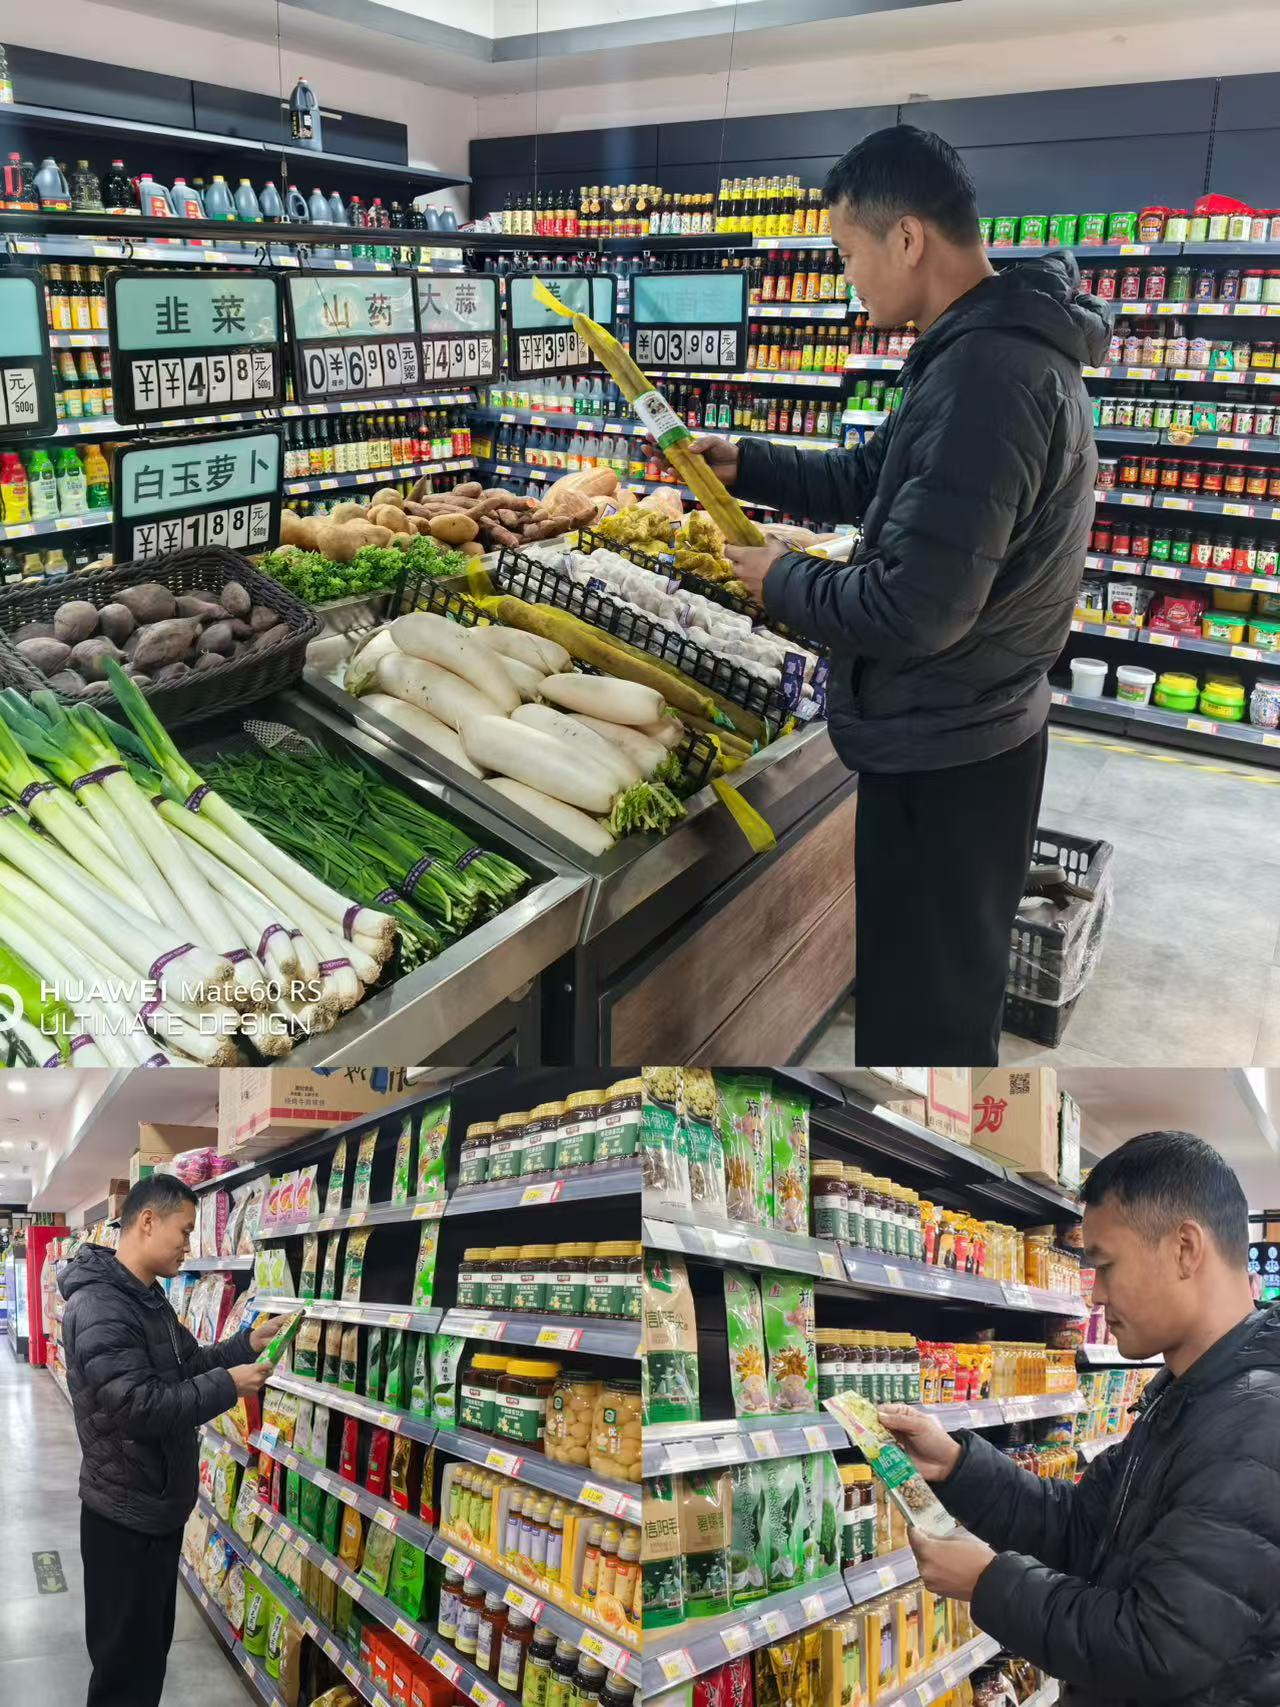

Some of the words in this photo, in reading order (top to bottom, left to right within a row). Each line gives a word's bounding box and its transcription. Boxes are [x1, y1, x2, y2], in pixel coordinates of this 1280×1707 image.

[156, 295, 246, 335] 韭菜
[323, 292, 393, 329] 山药
[133, 450, 270, 503] 白玉萝卜
[973, 1095, 1009, 1135] 方
